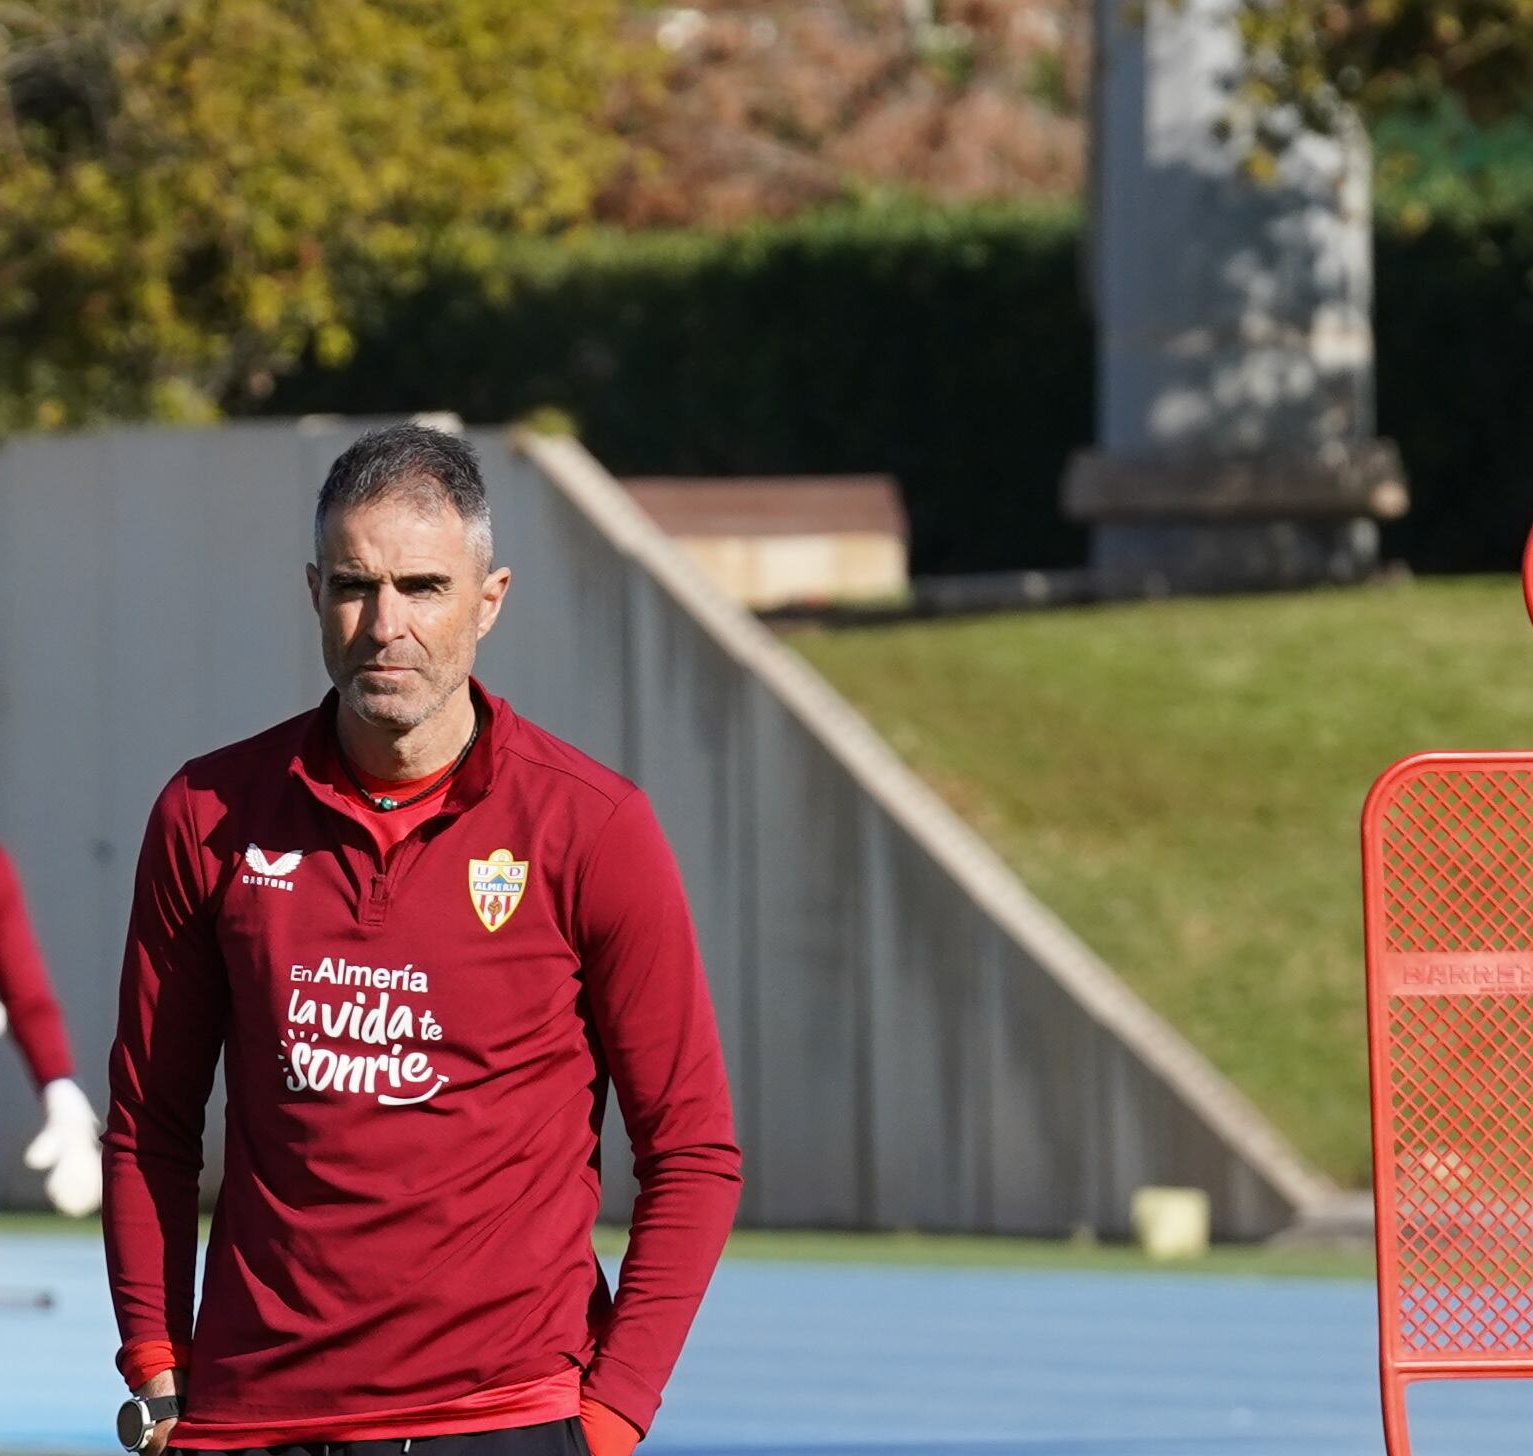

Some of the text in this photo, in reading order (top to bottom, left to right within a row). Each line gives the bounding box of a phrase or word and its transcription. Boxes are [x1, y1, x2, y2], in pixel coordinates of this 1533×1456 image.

[242, 874, 294, 892] CASTORE
[290, 957, 429, 993] En Almería
[288, 988, 443, 1046] la vida te
